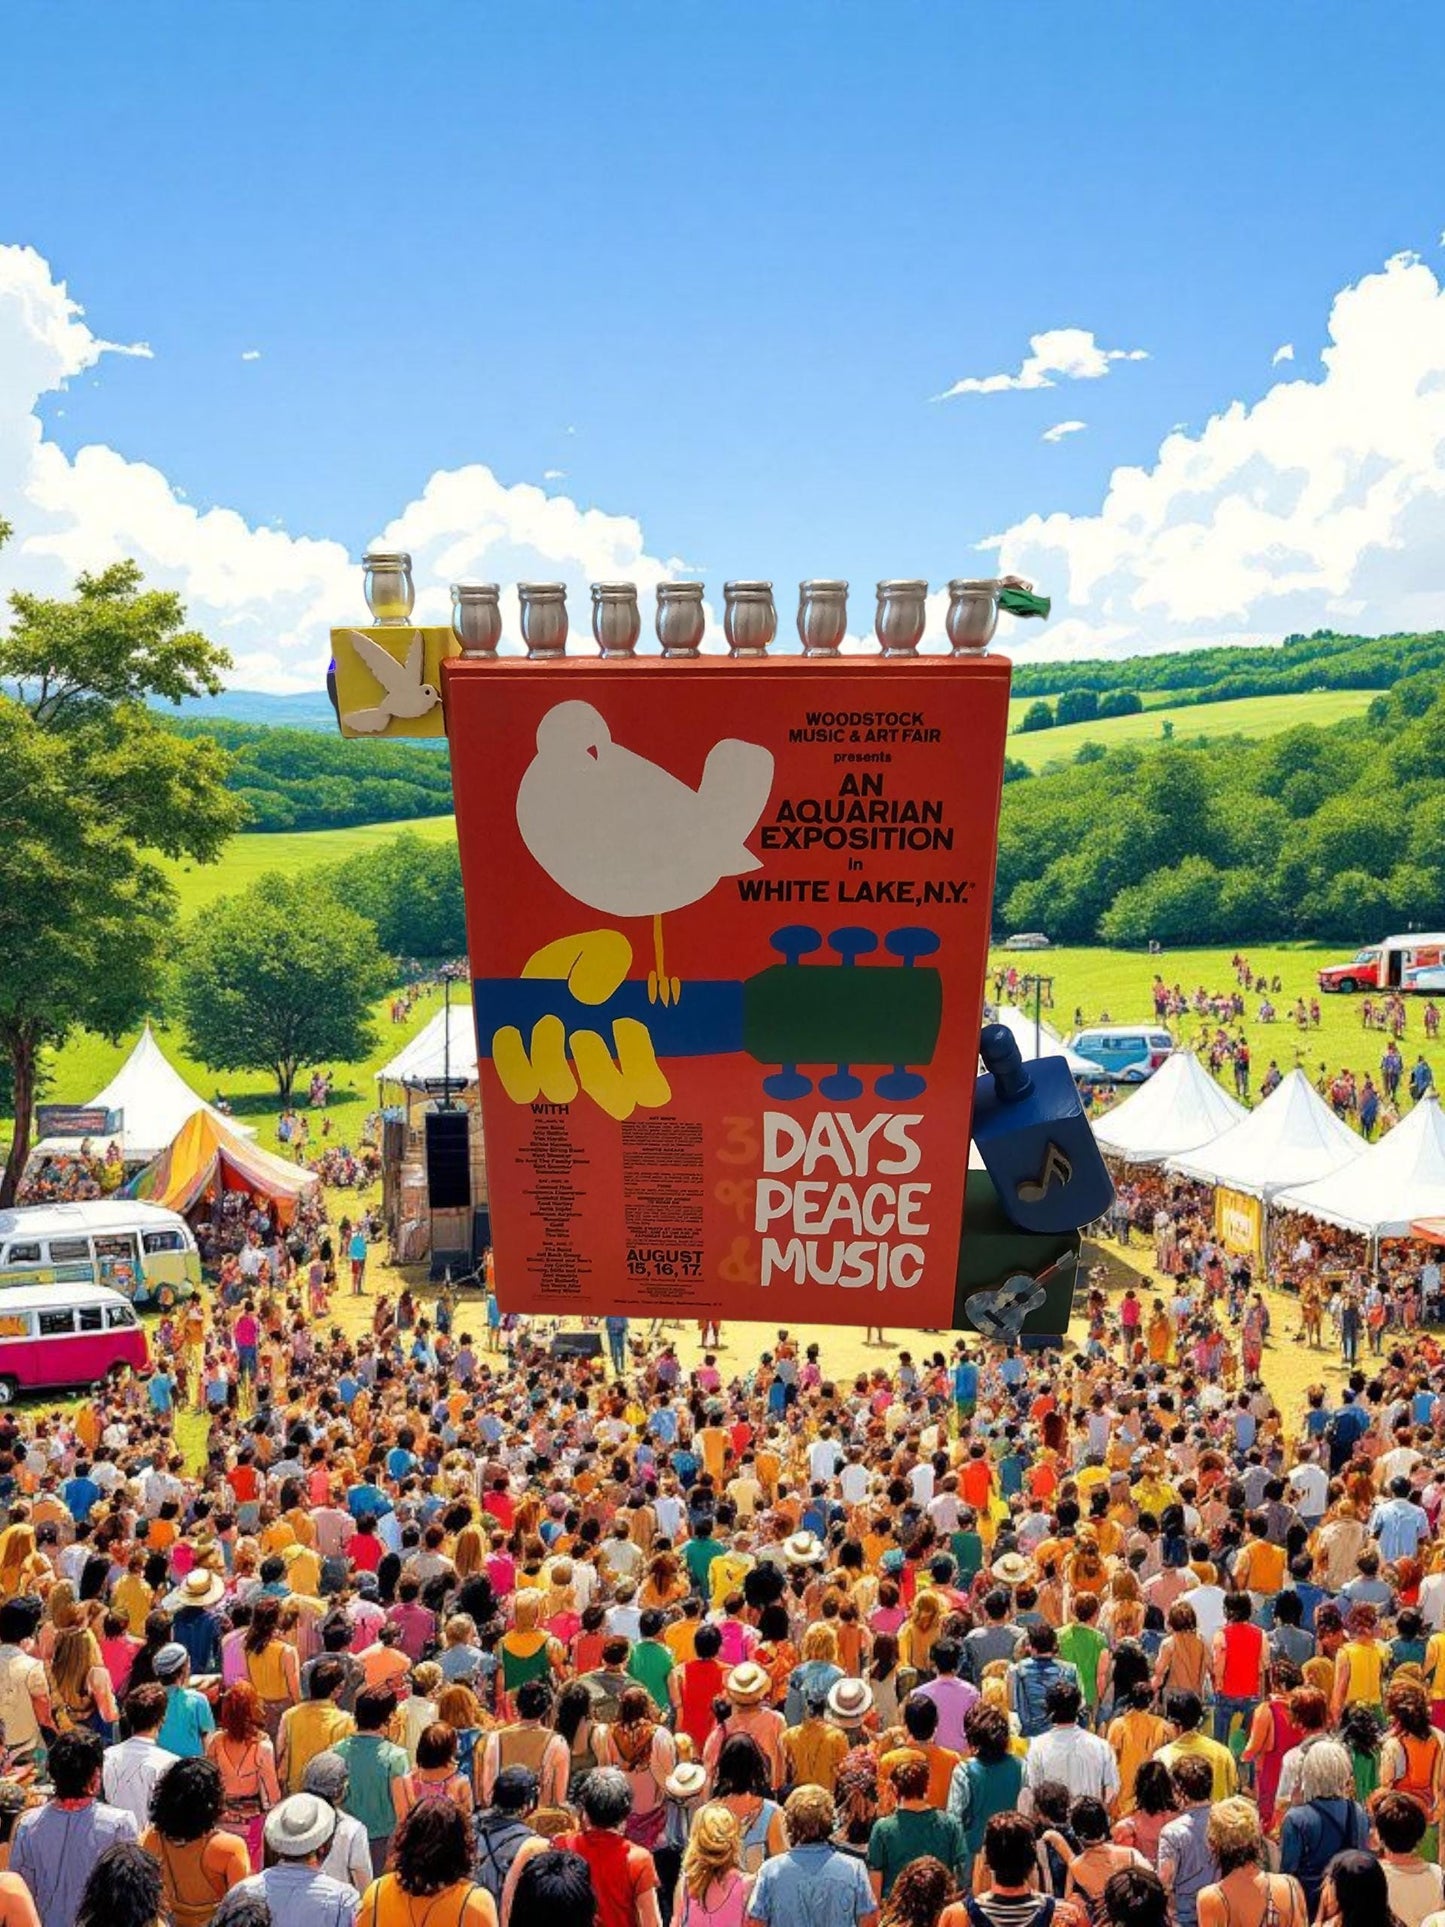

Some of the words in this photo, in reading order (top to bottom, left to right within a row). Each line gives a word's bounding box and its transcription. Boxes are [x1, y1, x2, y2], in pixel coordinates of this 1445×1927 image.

[806, 711, 925, 726] WOODSTOCK
[789, 729, 845, 742] MUSIC
[849, 730, 861, 743] &
[864, 729, 899, 743] ART
[902, 729, 941, 743] FAIR
[833, 751, 892, 764] presents
[838, 773, 884, 797] AN
[775, 799, 943, 825] AQUARIAN
[760, 826, 954, 851] EXPOSITION
[737, 879, 830, 903] WHITE
[530, 1104, 569, 1115] WITH
[716, 1115, 760, 1165] 3
[763, 1111, 925, 1177] DAYS
[754, 1178, 932, 1236] PEACE
[626, 1249, 704, 1264] AUGUST
[761, 1237, 926, 1292] MUSIC
[627, 1262, 651, 1277] 15,
[654, 1263, 679, 1278] 16,
[681, 1263, 702, 1276] 17.
